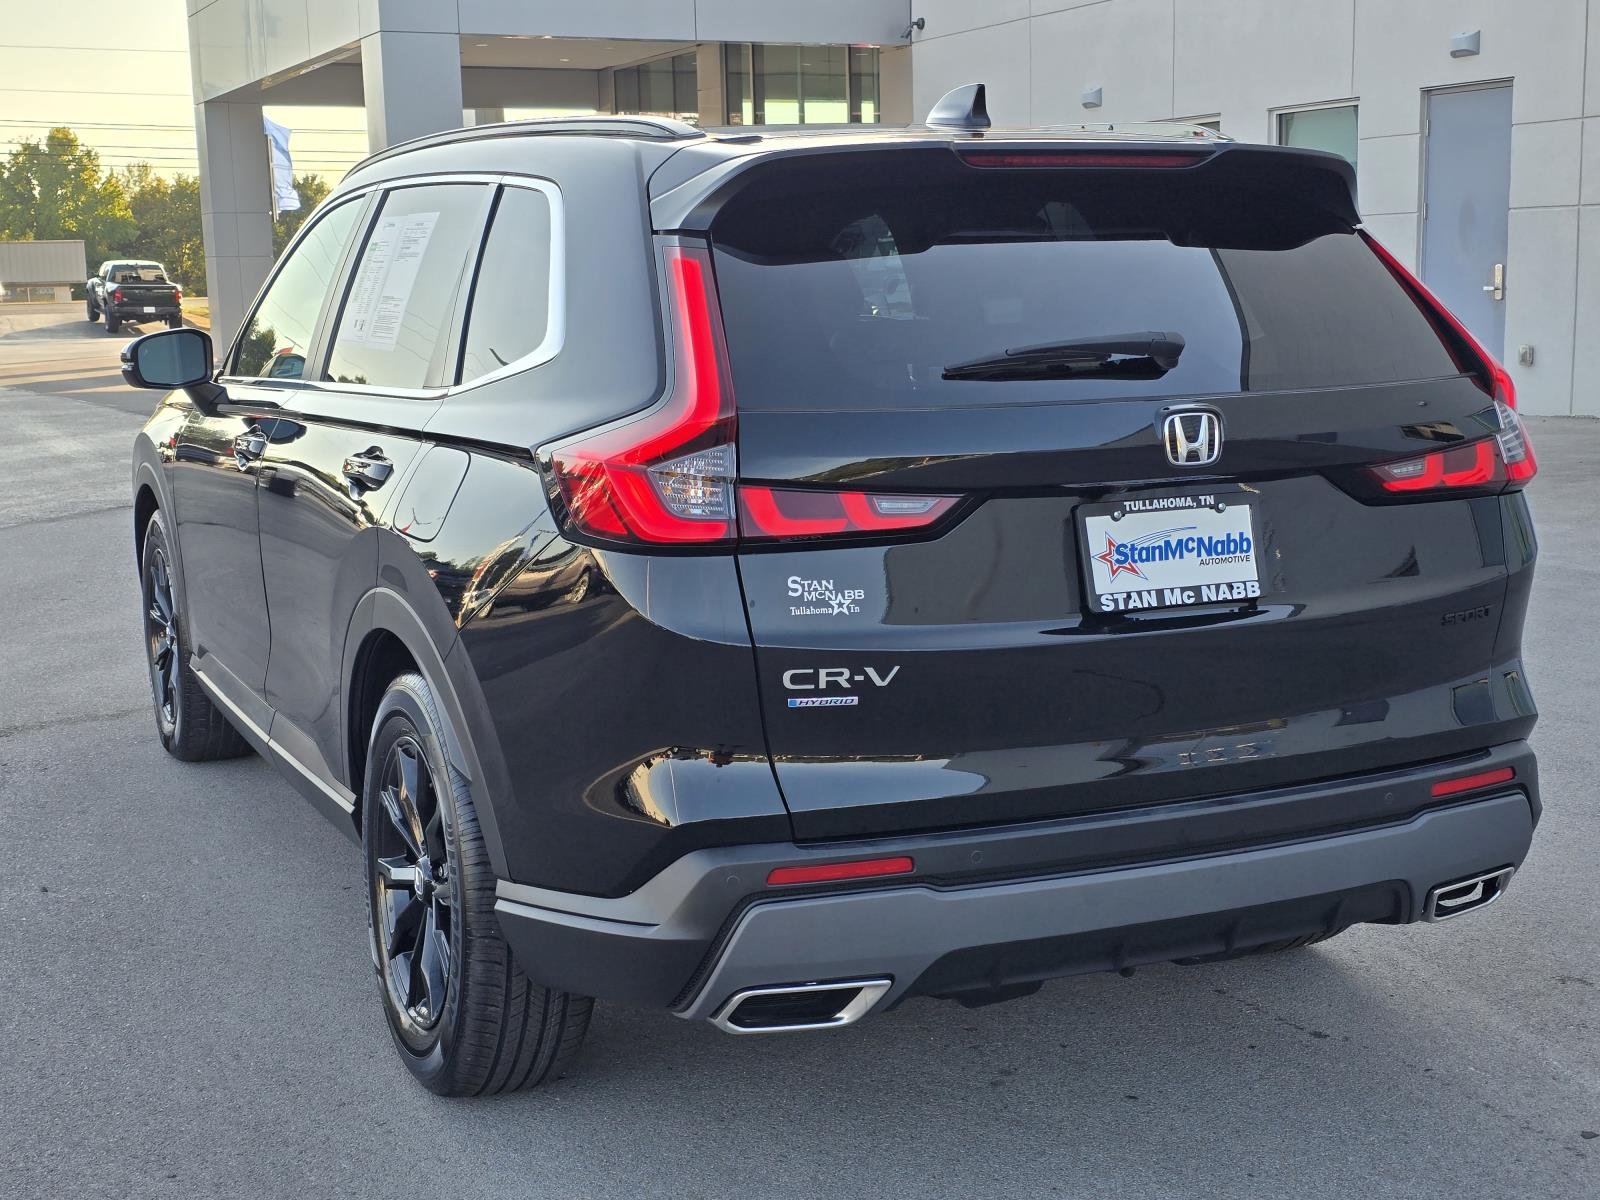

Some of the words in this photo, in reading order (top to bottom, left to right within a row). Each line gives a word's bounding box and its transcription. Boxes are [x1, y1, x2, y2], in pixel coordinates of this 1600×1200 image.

[1124, 497, 1196, 512] TULLAHOMA,
[1199, 495, 1214, 506] TN
[1199, 555, 1250, 567] AUTOMOTIVE
[787, 576, 834, 597] STAN
[1100, 591, 1157, 612] STAN
[1165, 589, 1195, 606] Mc
[1201, 581, 1261, 602] NABB
[790, 606, 833, 615] Tullahoma
[783, 665, 900, 690] CR-V
[798, 698, 854, 706] HYBRID
